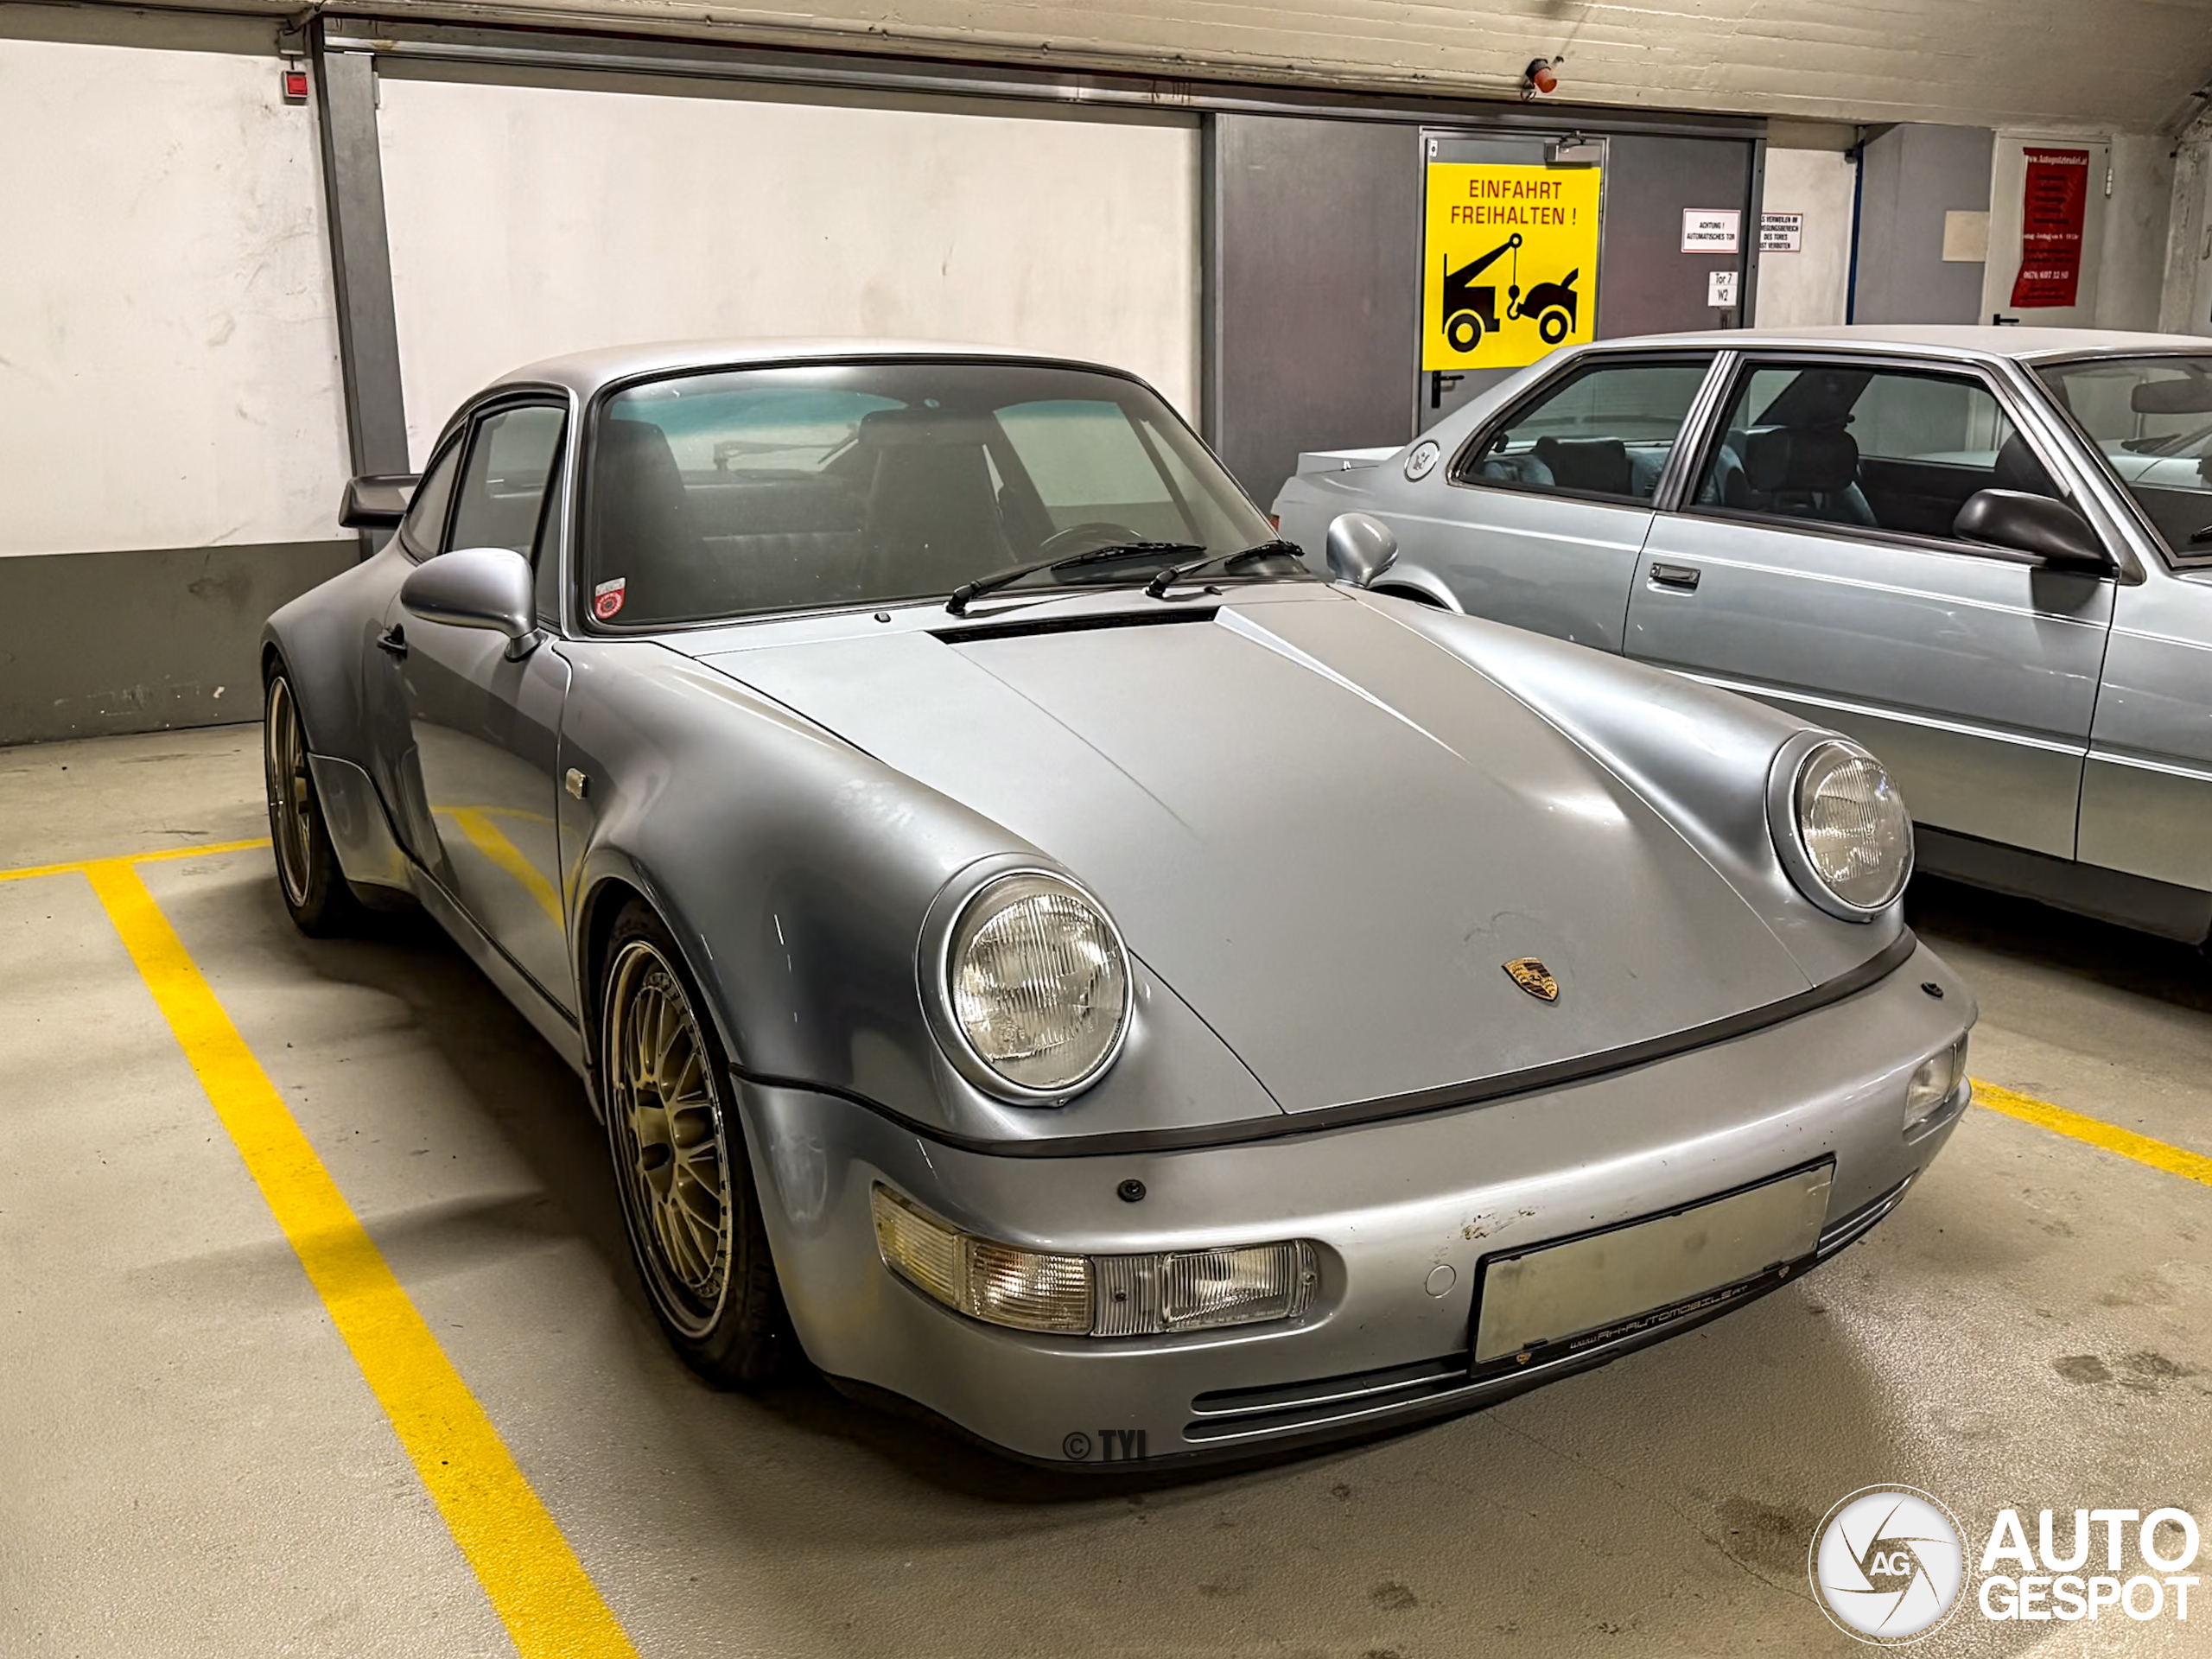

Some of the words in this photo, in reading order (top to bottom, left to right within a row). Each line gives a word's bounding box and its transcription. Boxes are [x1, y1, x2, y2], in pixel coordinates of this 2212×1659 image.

[1469, 180, 1562, 200] EINFAHRT
[1451, 206, 1565, 226] FREIHALTEN
[1572, 207, 1577, 226] !
[1715, 273, 1726, 284] Tor
[1728, 273, 1732, 284] 7
[1718, 289, 1728, 302] W2
